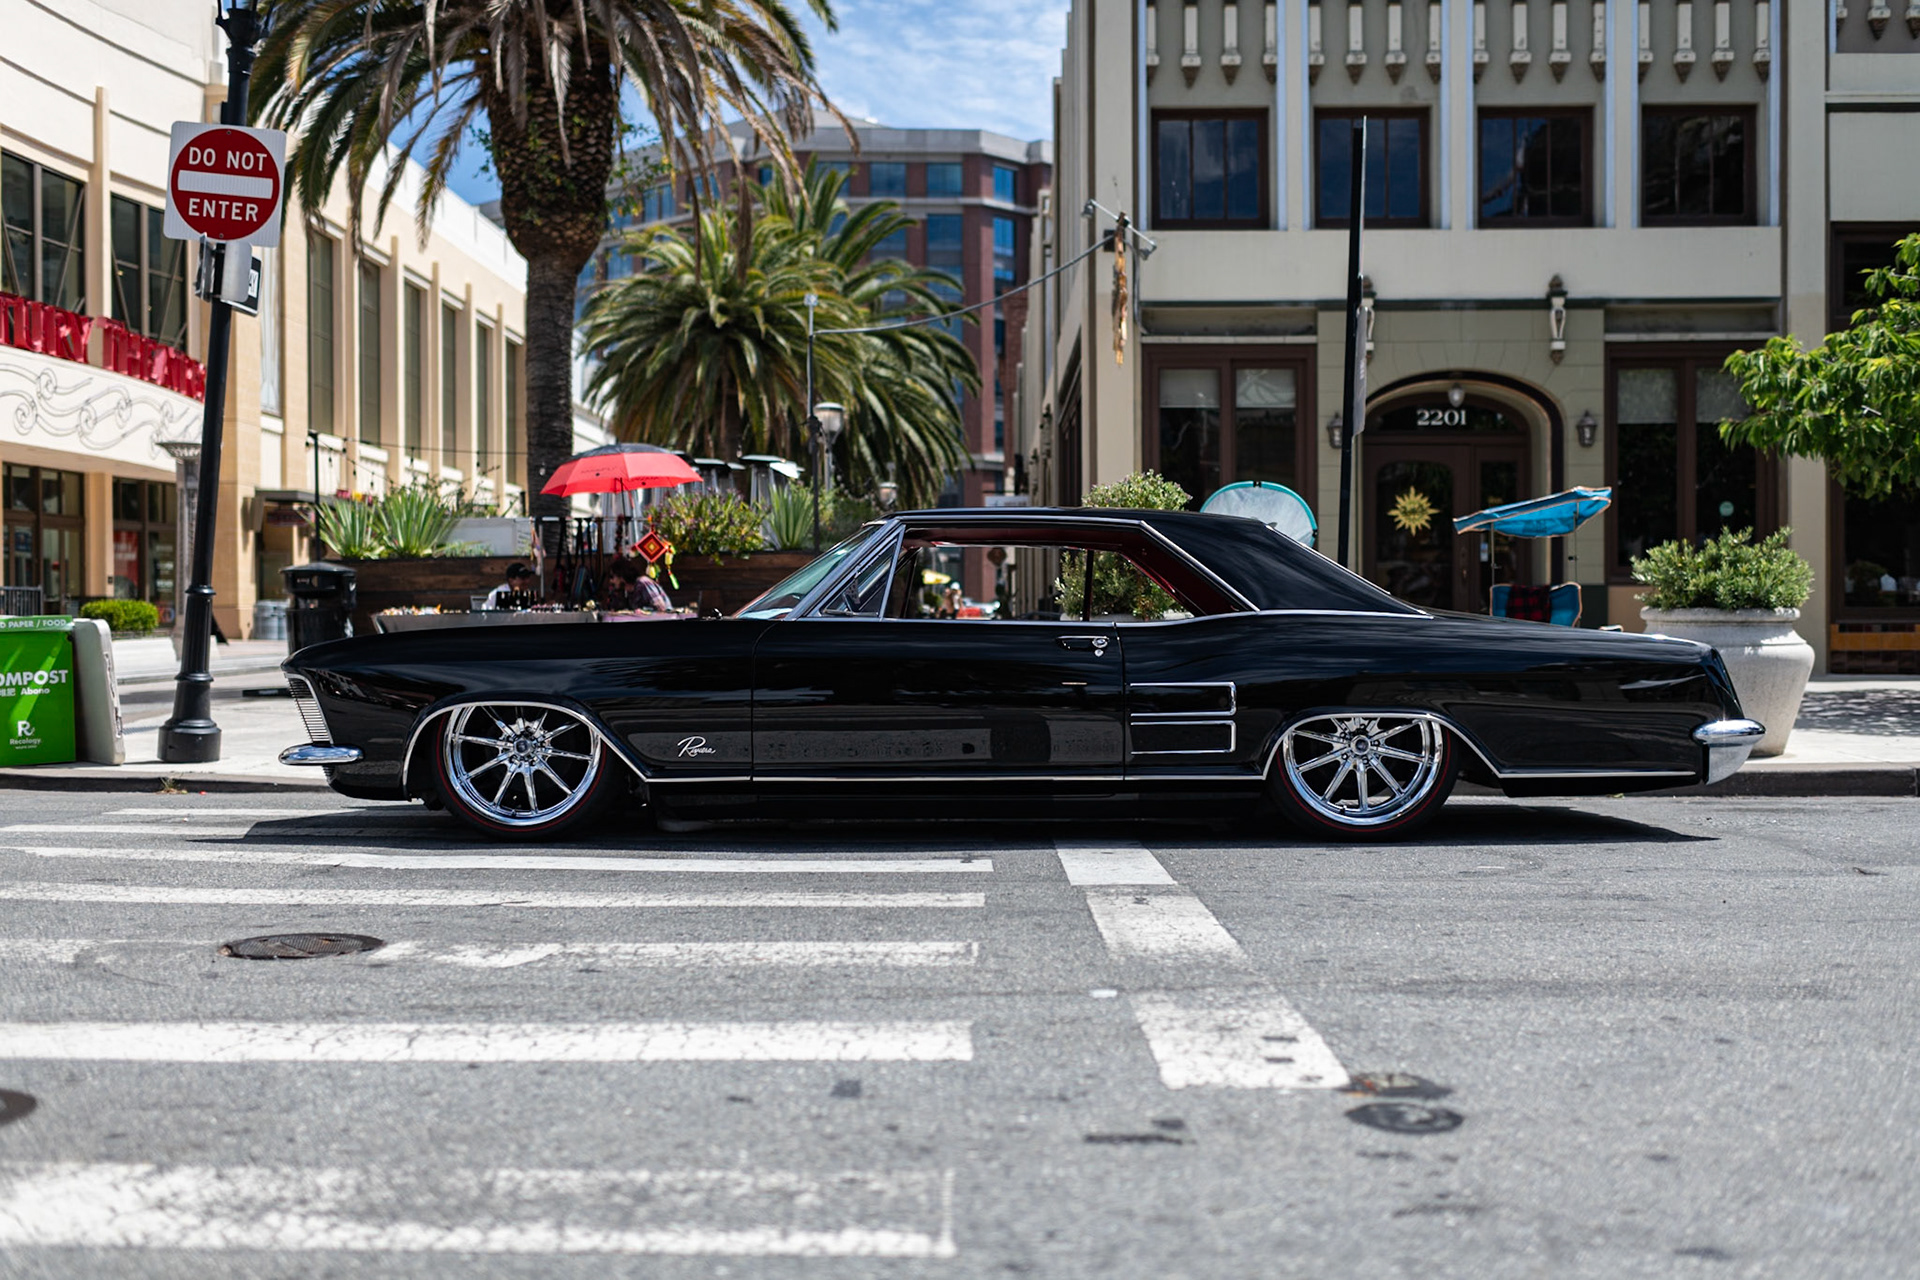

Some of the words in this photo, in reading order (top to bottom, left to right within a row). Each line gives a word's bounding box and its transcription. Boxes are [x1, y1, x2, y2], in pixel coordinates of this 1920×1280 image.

[189, 146, 217, 167] DO
[226, 150, 267, 172] NOT
[188, 197, 259, 222] ENTER
[1416, 408, 1467, 426] 2201
[8, 620, 34, 629] PAPER
[43, 618, 67, 627] FOOD
[21, 686, 51, 695] Abono
